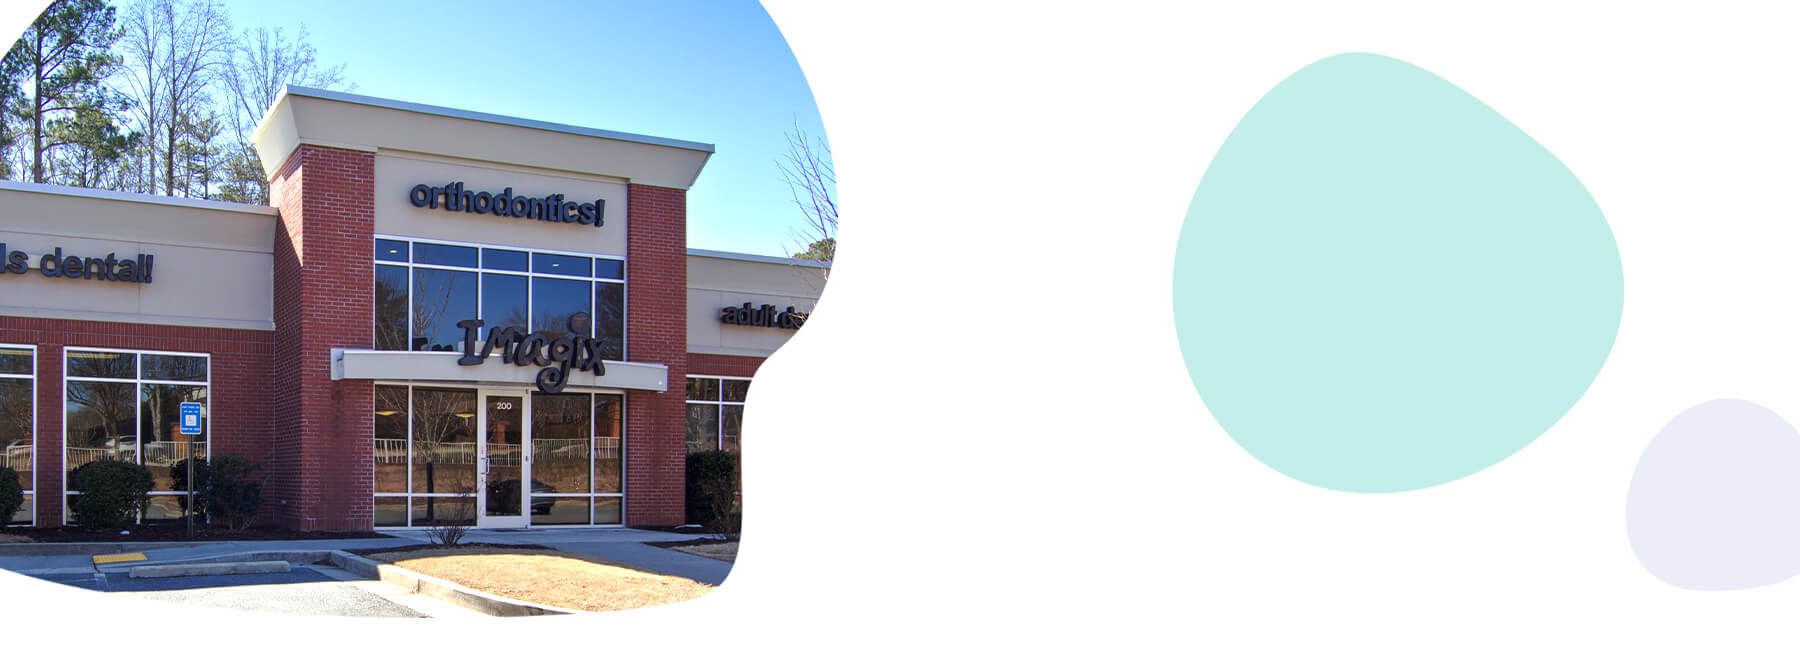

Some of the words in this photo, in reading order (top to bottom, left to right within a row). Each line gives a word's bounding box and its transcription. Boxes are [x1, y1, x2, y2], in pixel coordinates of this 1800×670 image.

[410, 181, 605, 227] orthodontics!
[40, 247, 154, 283] dental!
[720, 302, 778, 328] adult
[496, 401, 512, 410] 200
